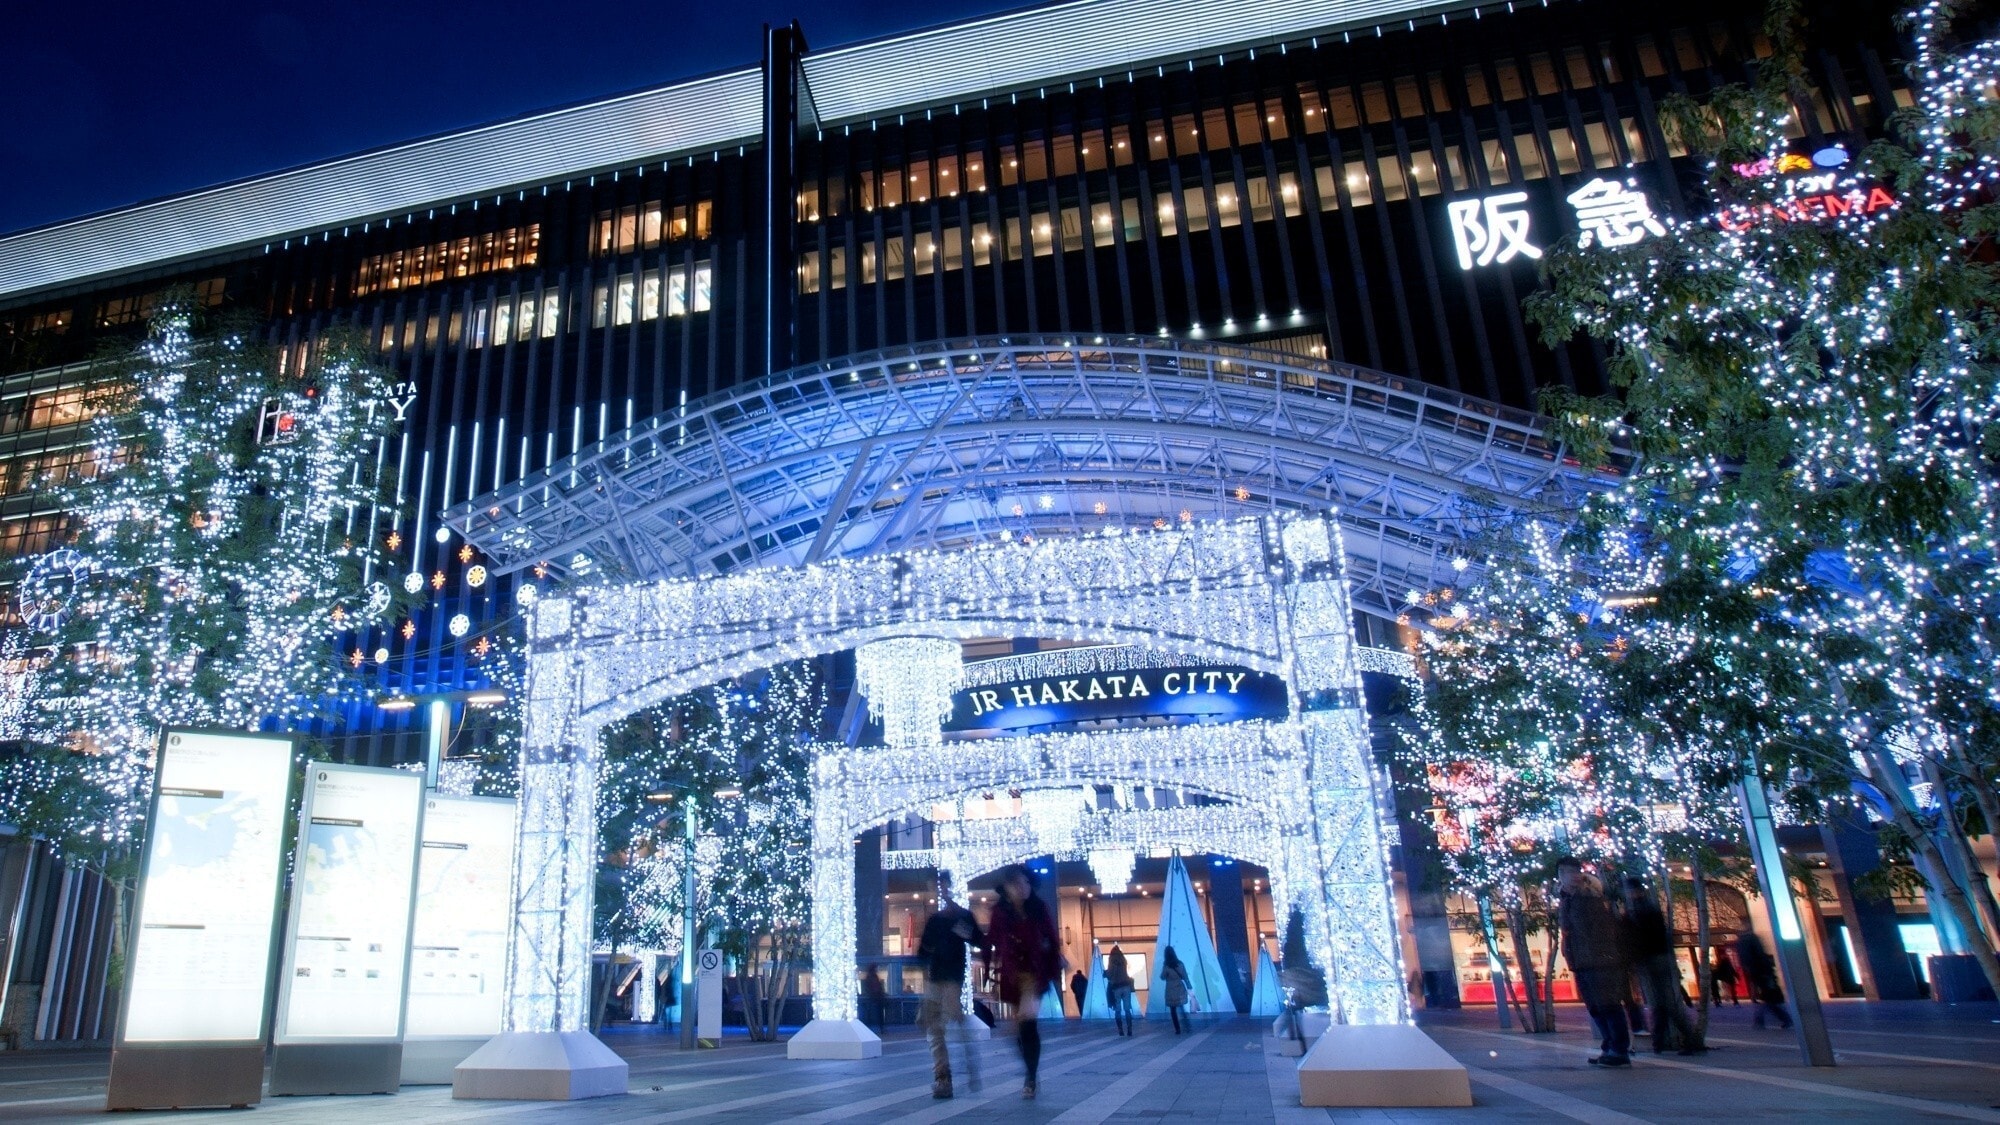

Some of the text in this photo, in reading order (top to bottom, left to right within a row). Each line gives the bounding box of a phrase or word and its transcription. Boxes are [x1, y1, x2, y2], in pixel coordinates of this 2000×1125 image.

[1447, 177, 1666, 270] 阪急
[969, 671, 1246, 716] JR HAKATA CITY
